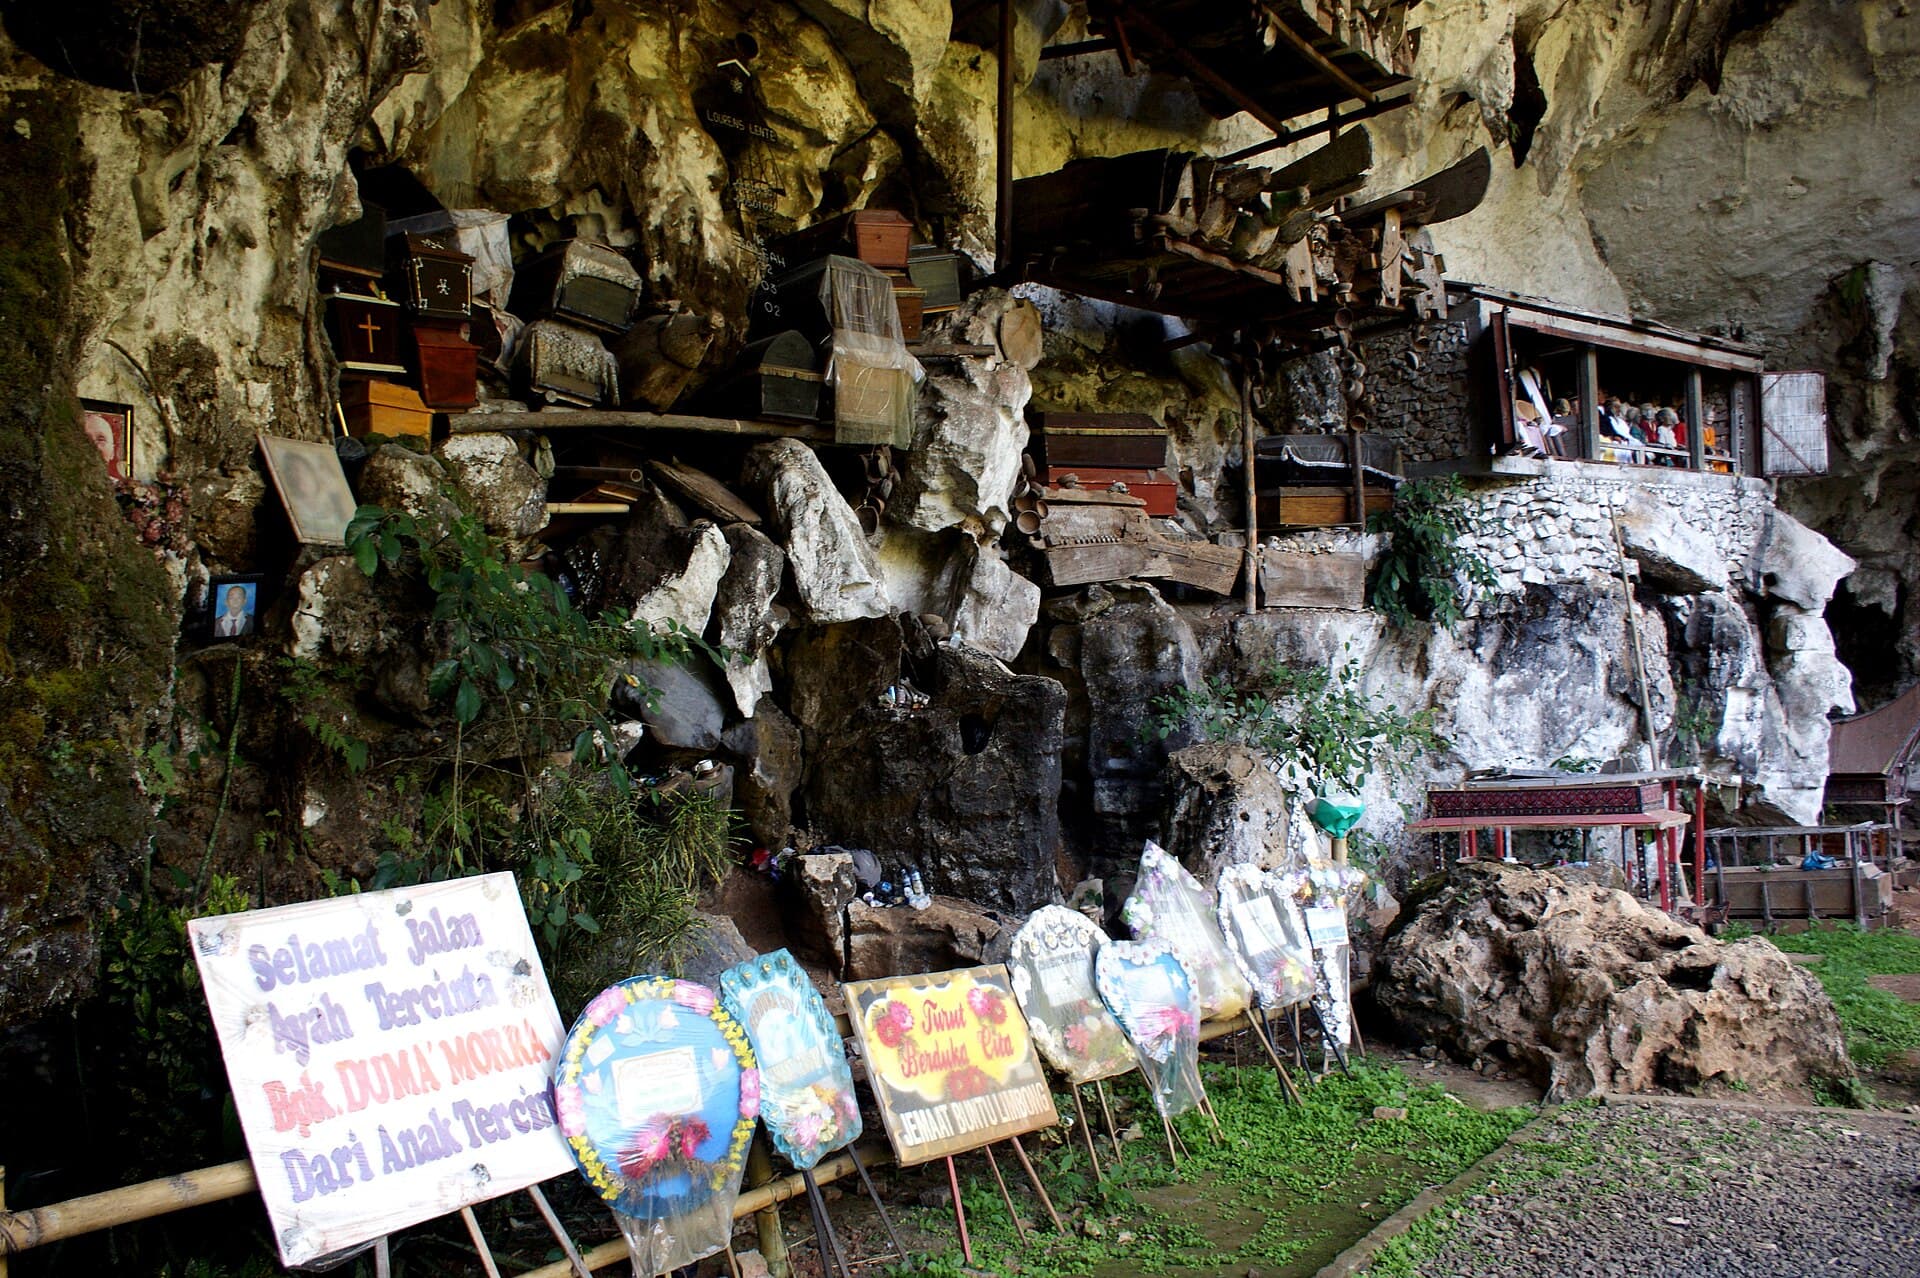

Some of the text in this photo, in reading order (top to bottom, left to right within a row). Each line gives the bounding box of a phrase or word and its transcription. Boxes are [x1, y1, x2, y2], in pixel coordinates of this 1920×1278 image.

[248, 918, 388, 992] Selamat
[267, 963, 499, 1067] Ayah Tercinta
[922, 999, 967, 1036] Turut
[901, 1024, 1015, 1079] Berduka Cita
[900, 1082, 1050, 1147] JEMAAT BUNTU LIMBONG
[280, 1129, 374, 1204] Dari
[378, 1107, 463, 1175] Anak
